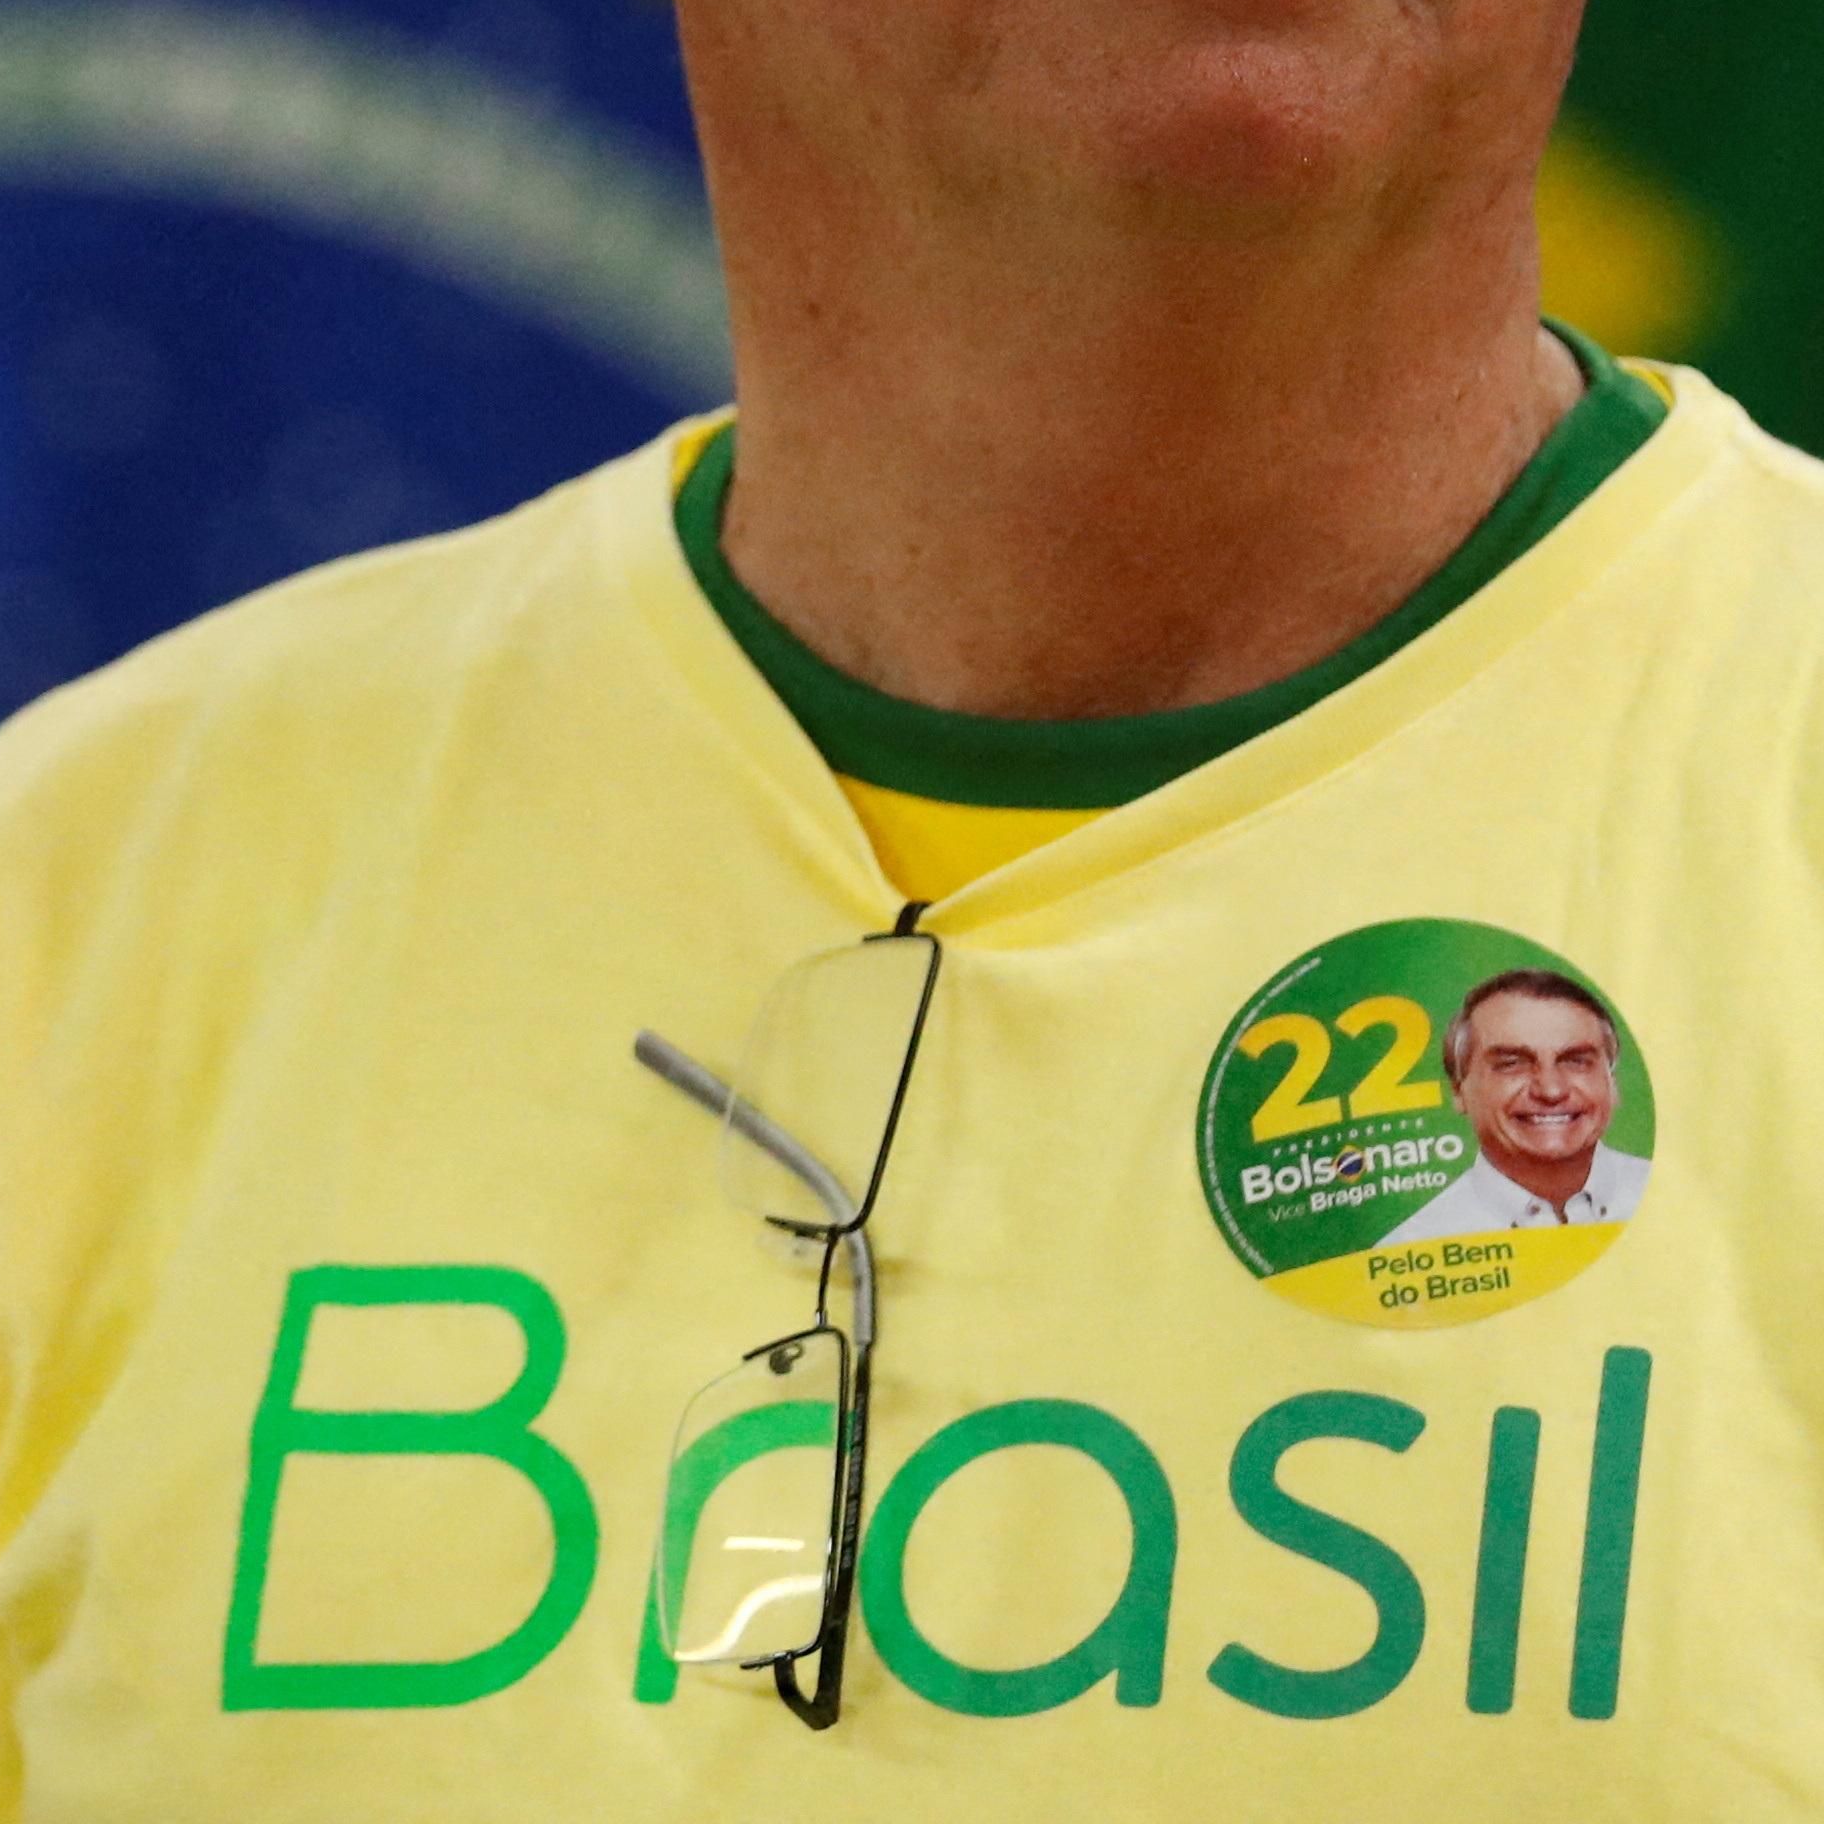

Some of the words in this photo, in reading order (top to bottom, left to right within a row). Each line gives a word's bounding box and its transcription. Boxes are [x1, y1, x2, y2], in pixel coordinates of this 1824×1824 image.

[1237, 995, 1443, 1144] 22
[1240, 1133, 1465, 1205] Bolsonaro
[1268, 1201, 1307, 1223] Vice
[1310, 1182, 1378, 1214] Braga
[1381, 1170, 1448, 1196] Netto
[1367, 1248, 1435, 1281] Pelo
[1442, 1241, 1515, 1268] Bem
[1378, 1282, 1420, 1309] do
[1426, 1266, 1511, 1301] Brasil
[222, 1263, 1654, 1720] Brasil
